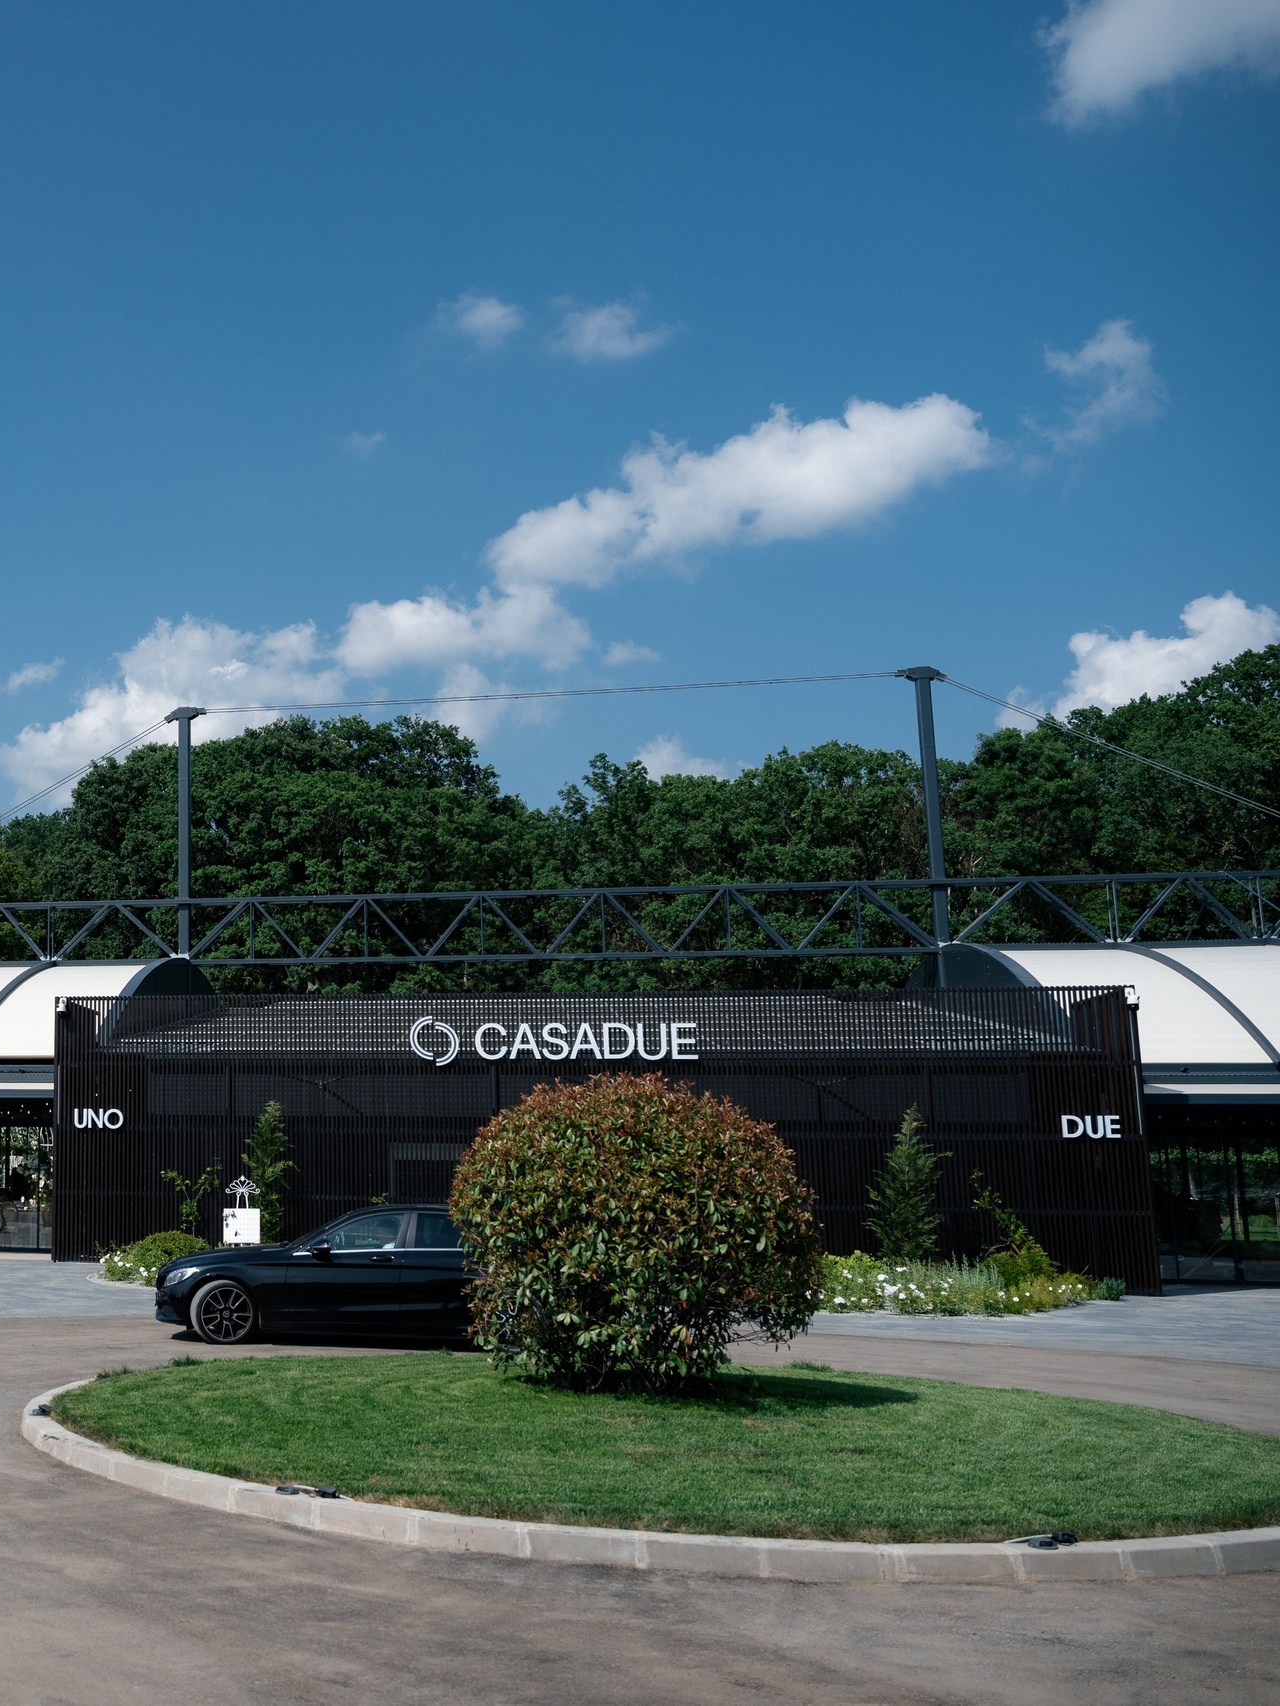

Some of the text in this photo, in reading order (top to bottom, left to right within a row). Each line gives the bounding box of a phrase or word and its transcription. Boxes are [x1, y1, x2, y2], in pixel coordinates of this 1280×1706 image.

[474, 1022, 699, 1061] CASADUE
[73, 1108, 124, 1130] UNO
[1061, 1114, 1122, 1139] DUE
